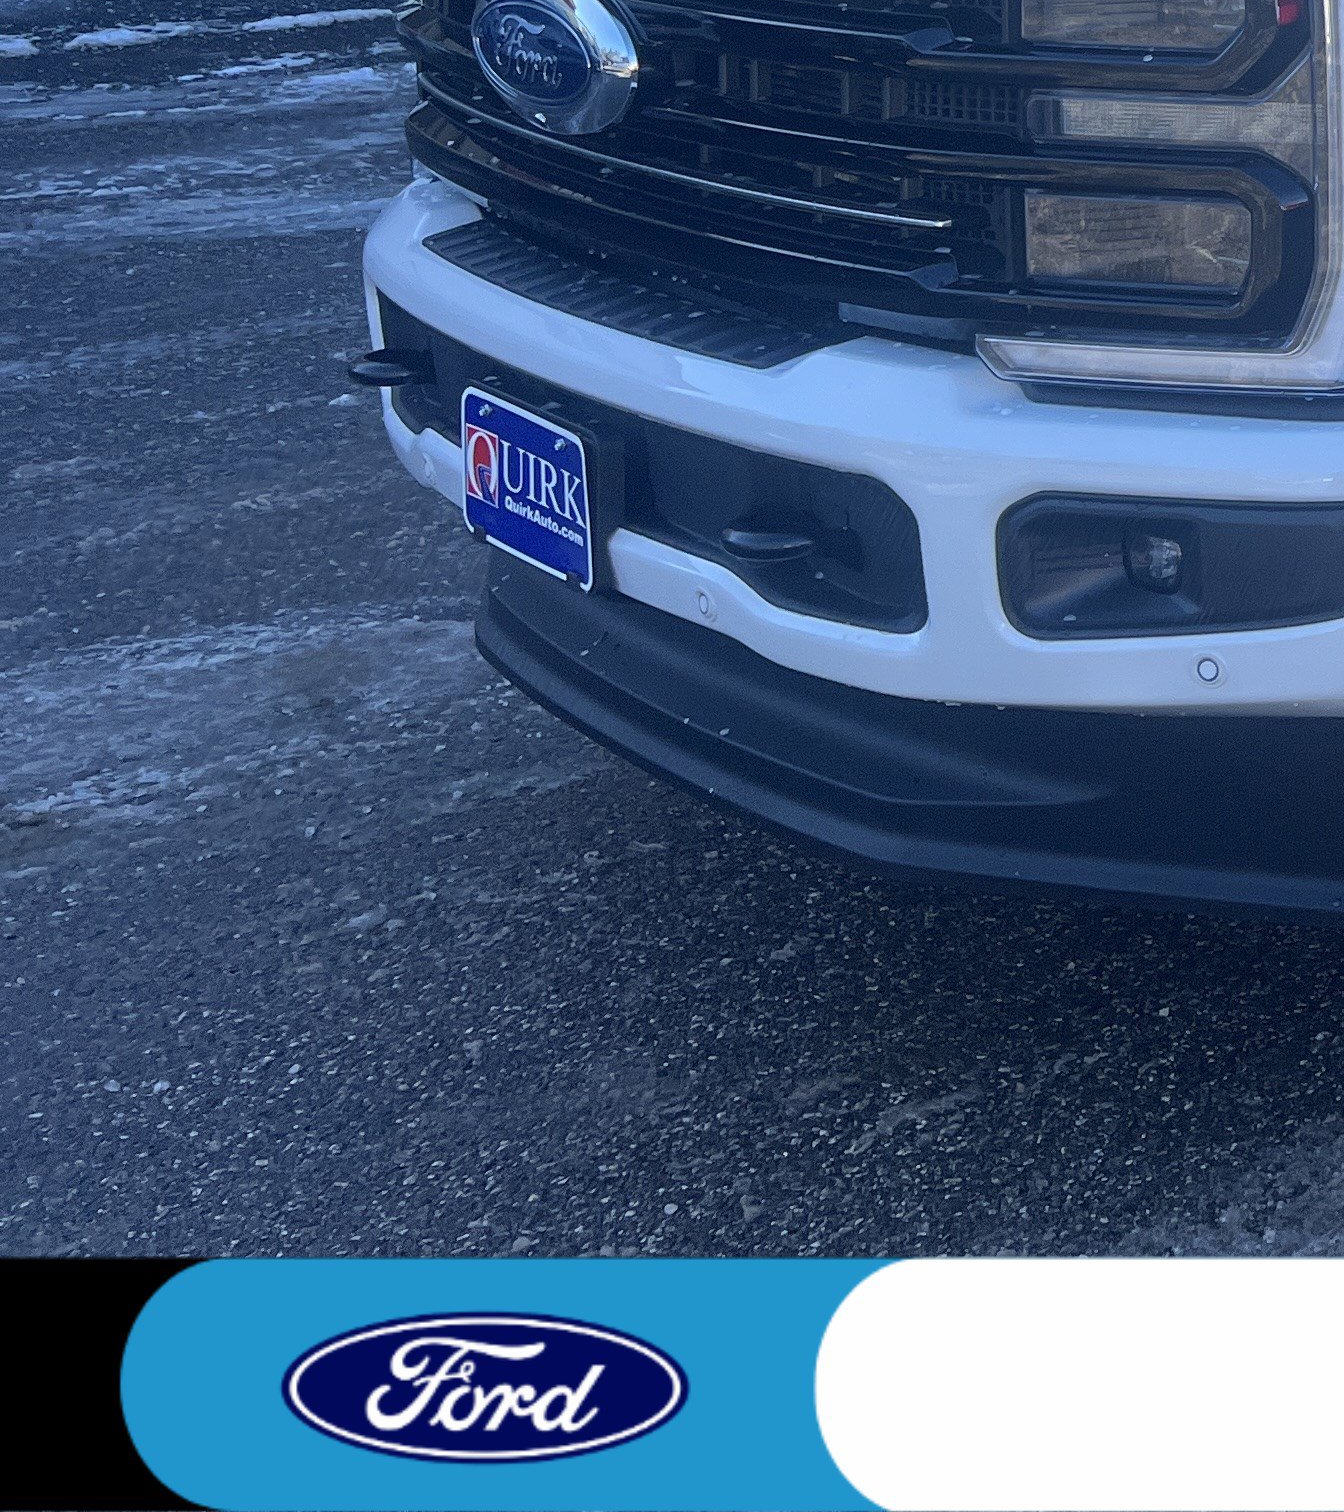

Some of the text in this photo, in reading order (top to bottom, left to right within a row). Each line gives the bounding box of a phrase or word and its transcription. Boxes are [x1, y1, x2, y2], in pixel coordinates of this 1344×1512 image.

[496, 14, 564, 90] Ford
[466, 430, 587, 530] QUIRK
[504, 495, 585, 548] QuirkAuto.com
